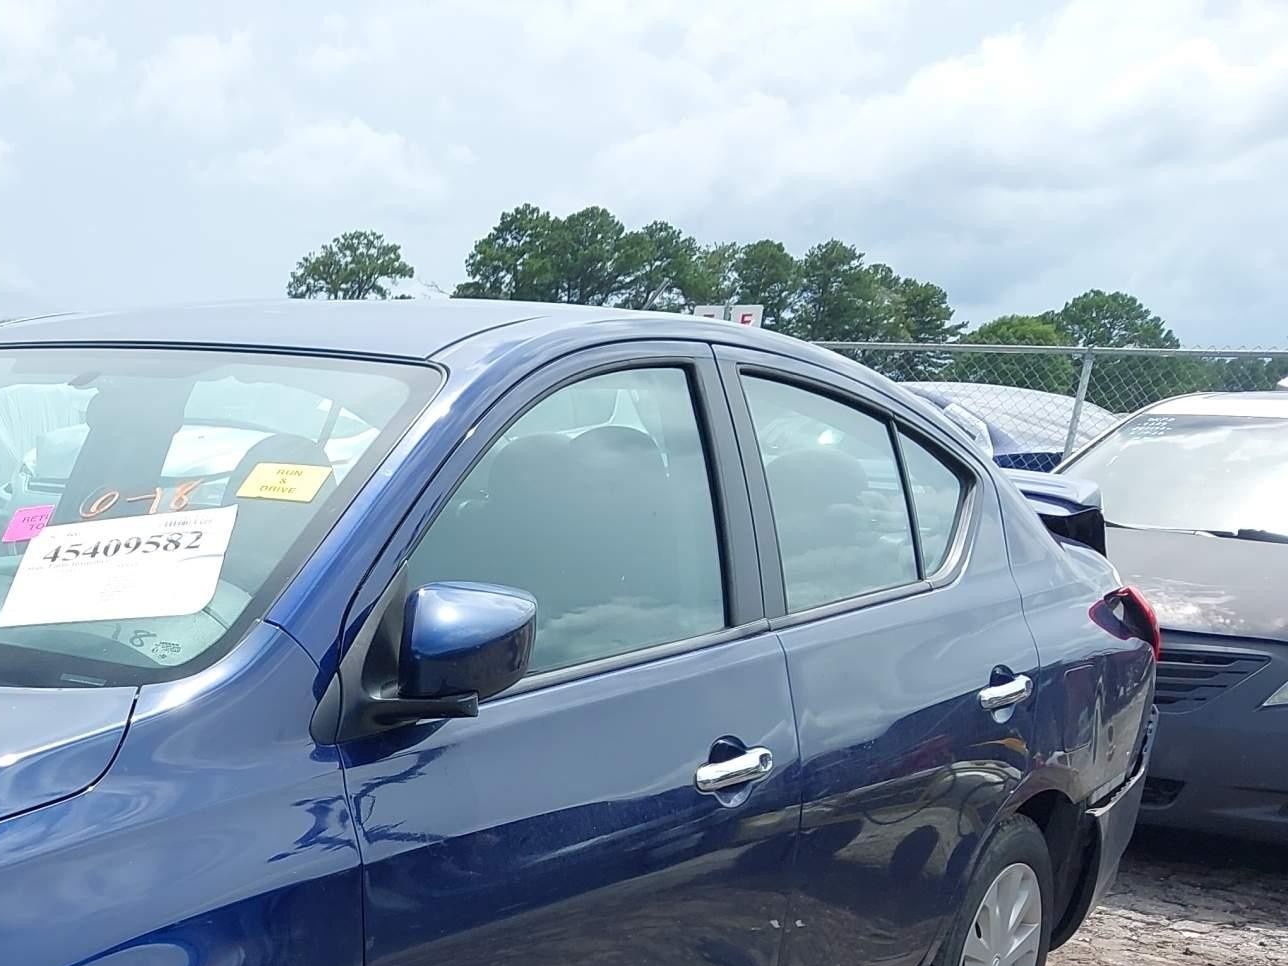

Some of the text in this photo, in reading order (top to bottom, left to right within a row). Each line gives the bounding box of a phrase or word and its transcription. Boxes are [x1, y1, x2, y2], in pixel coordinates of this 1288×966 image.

[276, 468, 304, 477] RUN
[279, 477, 288, 485] &
[259, 485, 297, 494] DRIVE
[42, 530, 203, 563] 45409582
